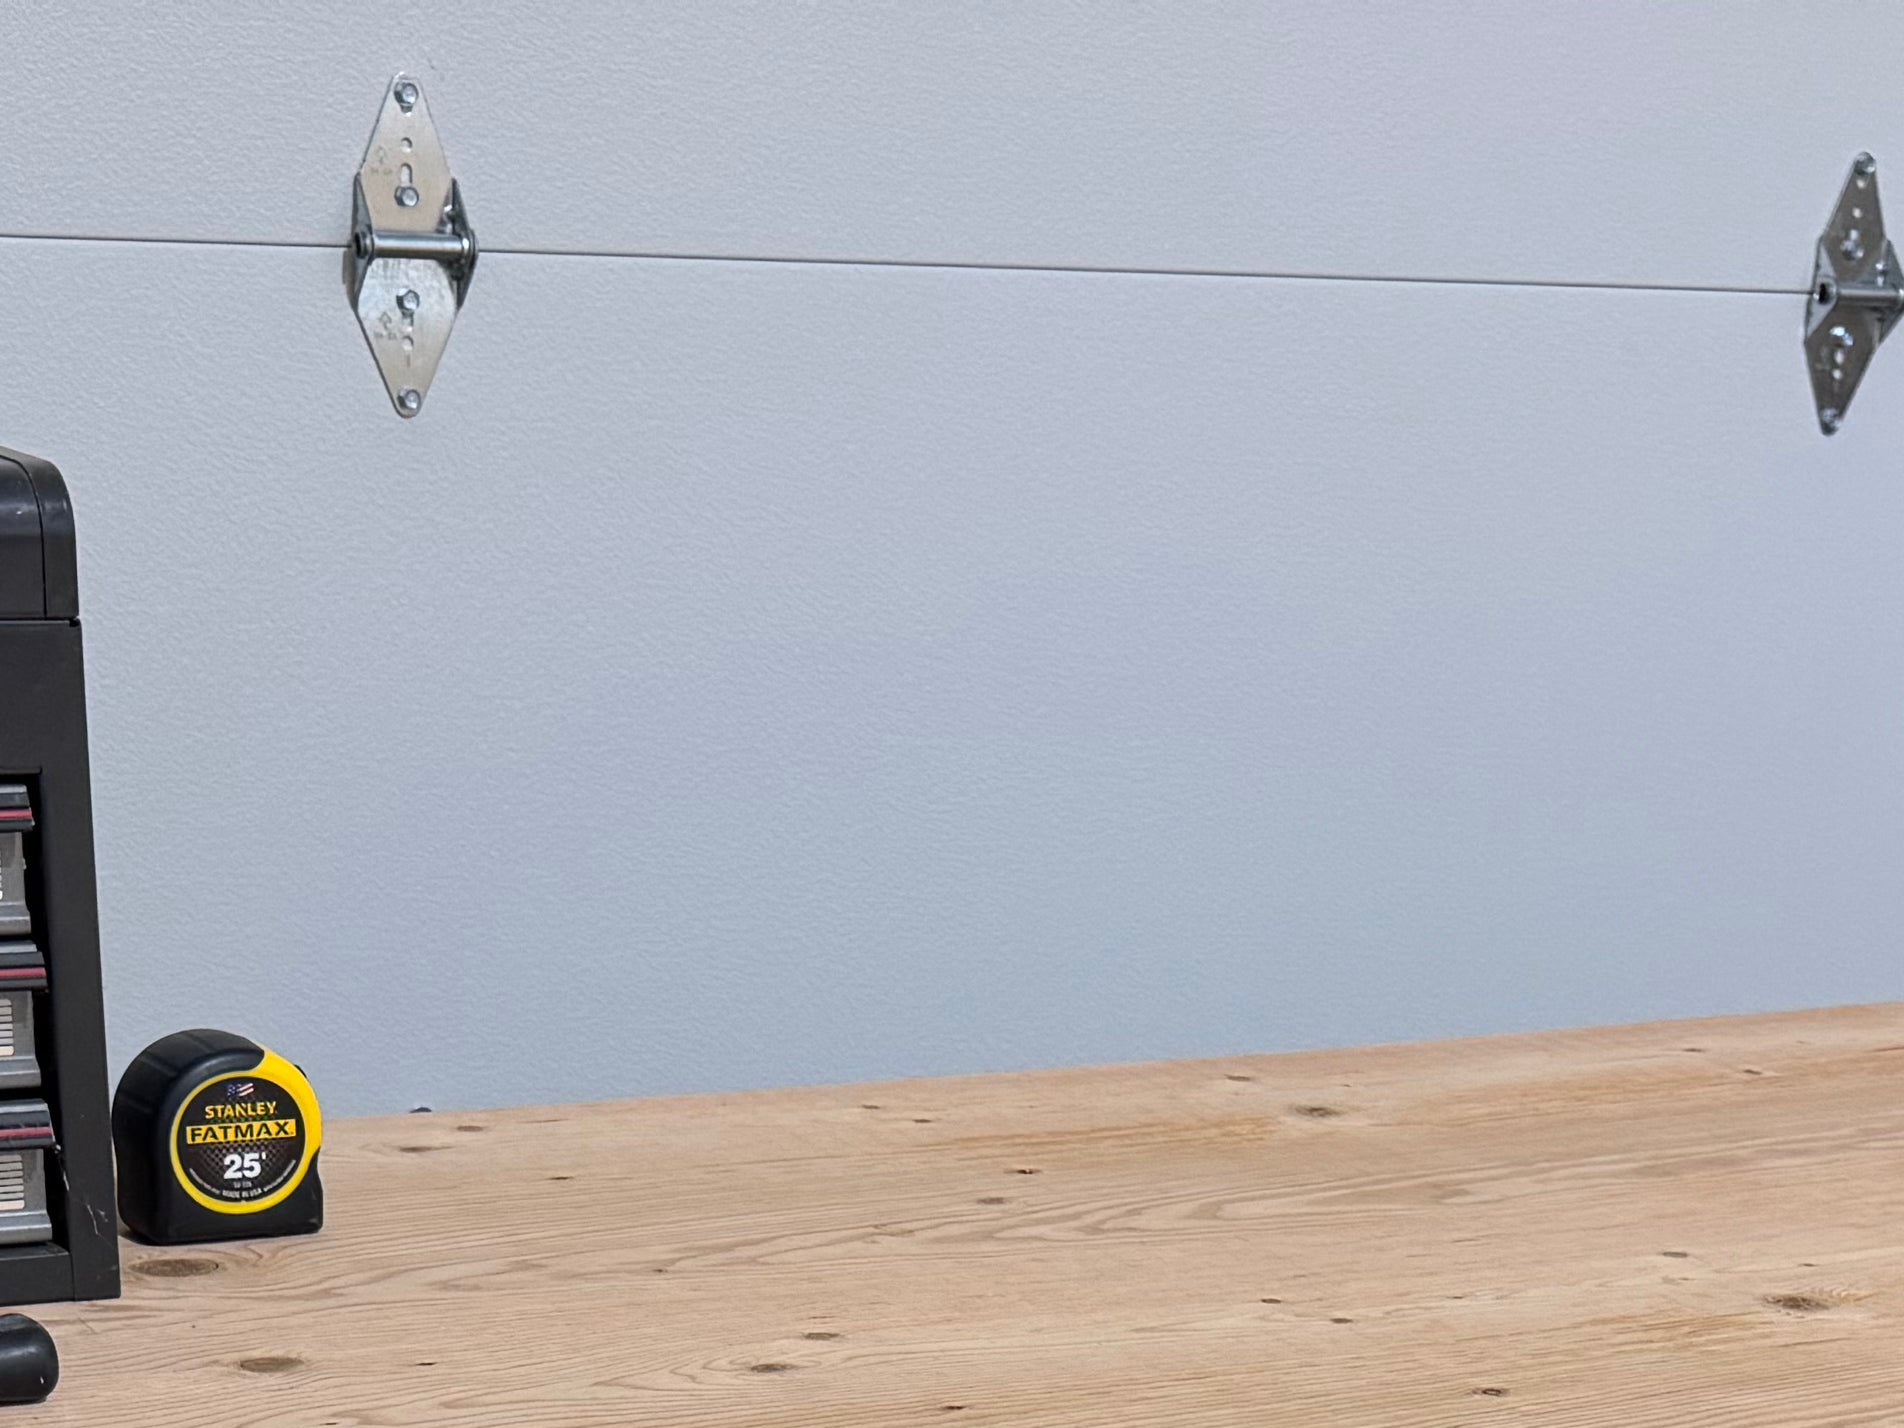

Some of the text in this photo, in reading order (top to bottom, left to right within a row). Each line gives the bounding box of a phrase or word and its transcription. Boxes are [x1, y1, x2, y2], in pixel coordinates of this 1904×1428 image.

[204, 1101, 277, 1119] STANLEY
[191, 1121, 290, 1142] FATMAX
[223, 1152, 267, 1180] 25'
